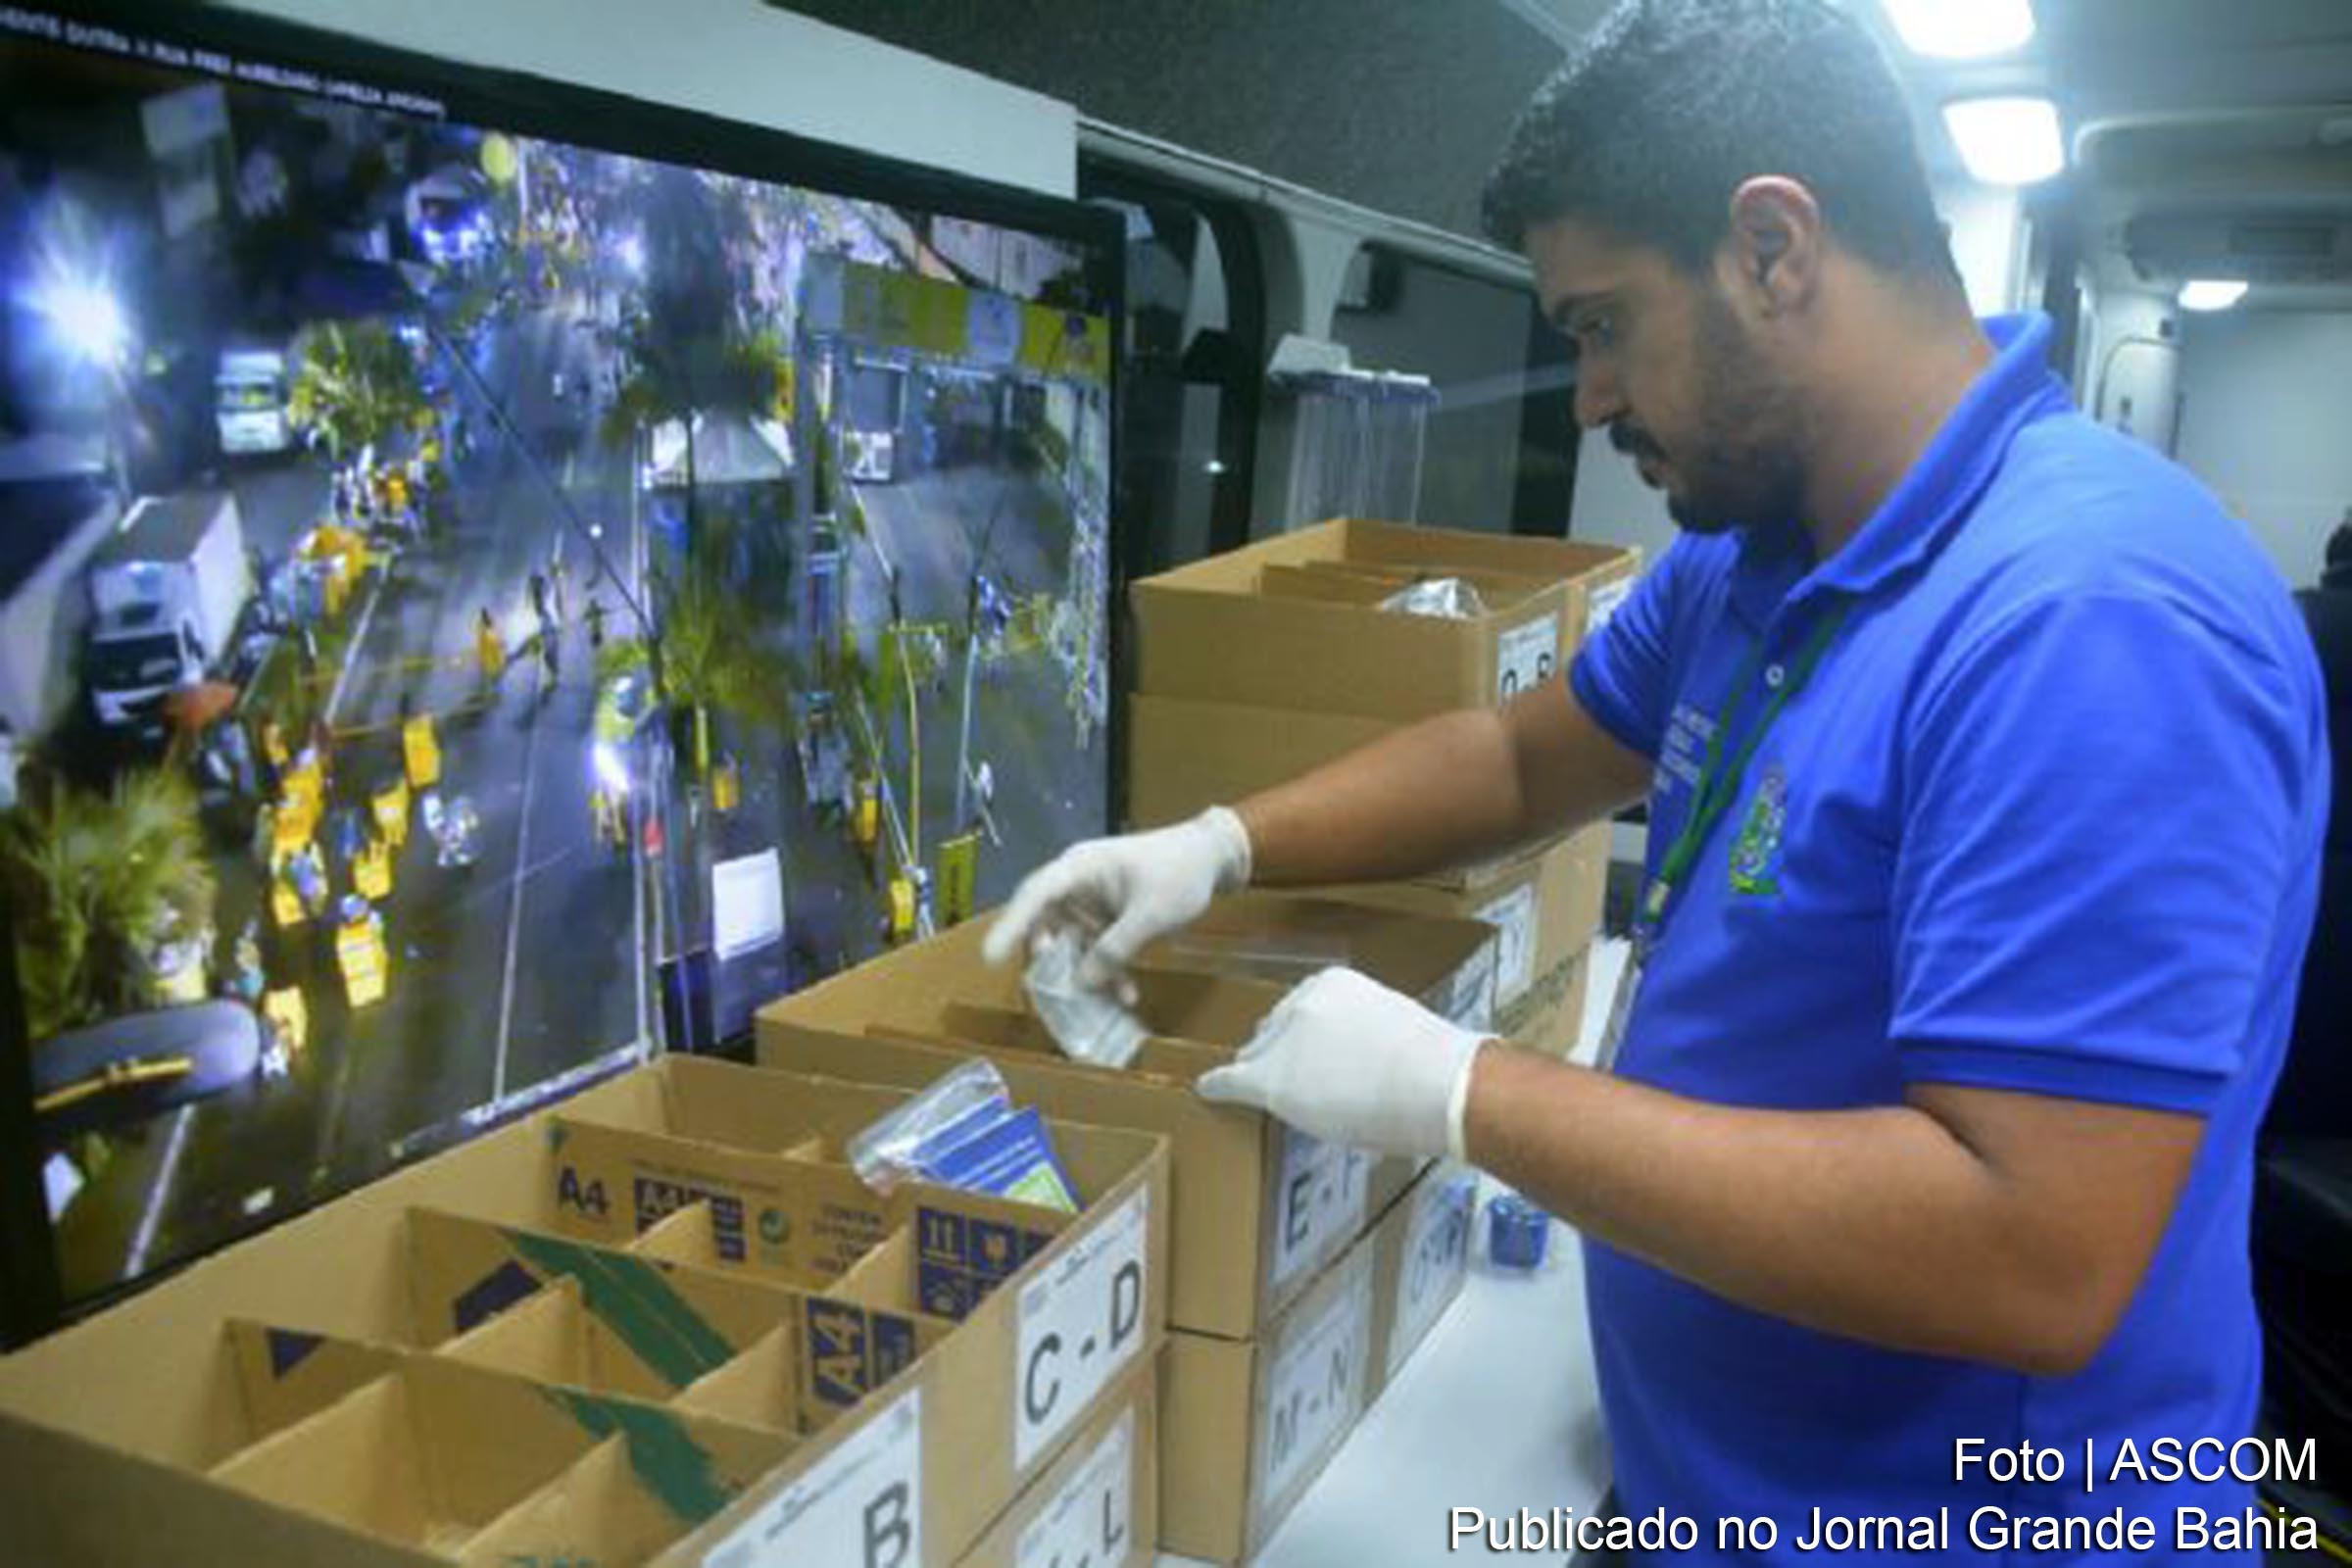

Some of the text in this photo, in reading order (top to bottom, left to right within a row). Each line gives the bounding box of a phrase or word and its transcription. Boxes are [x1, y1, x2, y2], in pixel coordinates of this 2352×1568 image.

[558, 1164, 609, 1216] A4
[1285, 1168, 1313, 1253] E
[812, 1313, 866, 1396] A4
[1025, 1332, 1062, 1426] C
[1109, 1259, 1141, 1351] D
[862, 1480, 912, 1568] B
[1102, 1488, 1125, 1556] L
